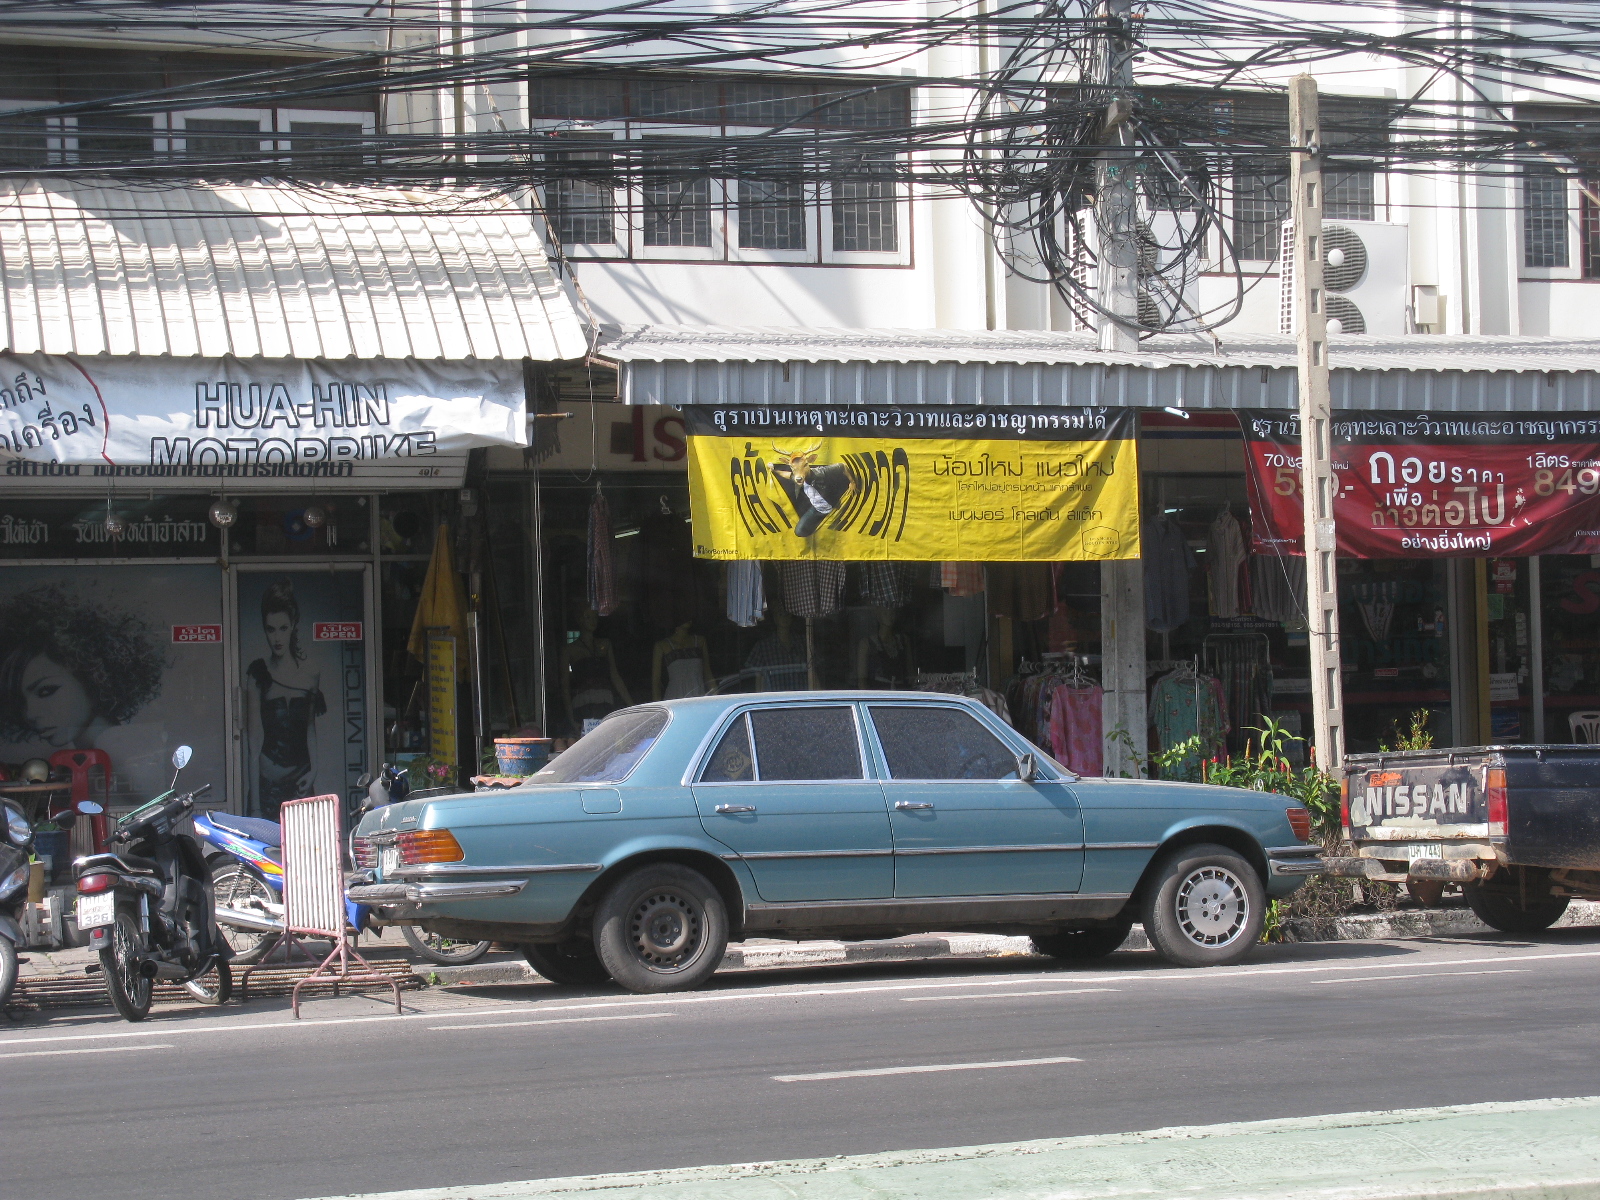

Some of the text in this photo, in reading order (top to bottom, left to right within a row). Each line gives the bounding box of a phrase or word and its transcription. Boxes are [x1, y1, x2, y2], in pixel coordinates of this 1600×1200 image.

[195, 381, 390, 429] HUA-HIN
[933, 453, 1116, 477] น้องใหม่ แนวใหม่
[1264, 453, 1285, 467] 70
[1368, 451, 1505, 484] ถอยราคา
[1535, 452, 1570, 468] ลิตร
[1371, 484, 1505, 526] ก้าวต่อไป
[1386, 484, 1422, 506] เพื่อ
[949, 507, 1005, 521] เบนมอร์
[1401, 530, 1492, 550] อย่างยิ่งใหญ่
[178, 633, 217, 641] OPEN
[319, 631, 358, 639] OPEN
[1366, 782, 1468, 816] NISSAN
[85, 913, 109, 926] 326
